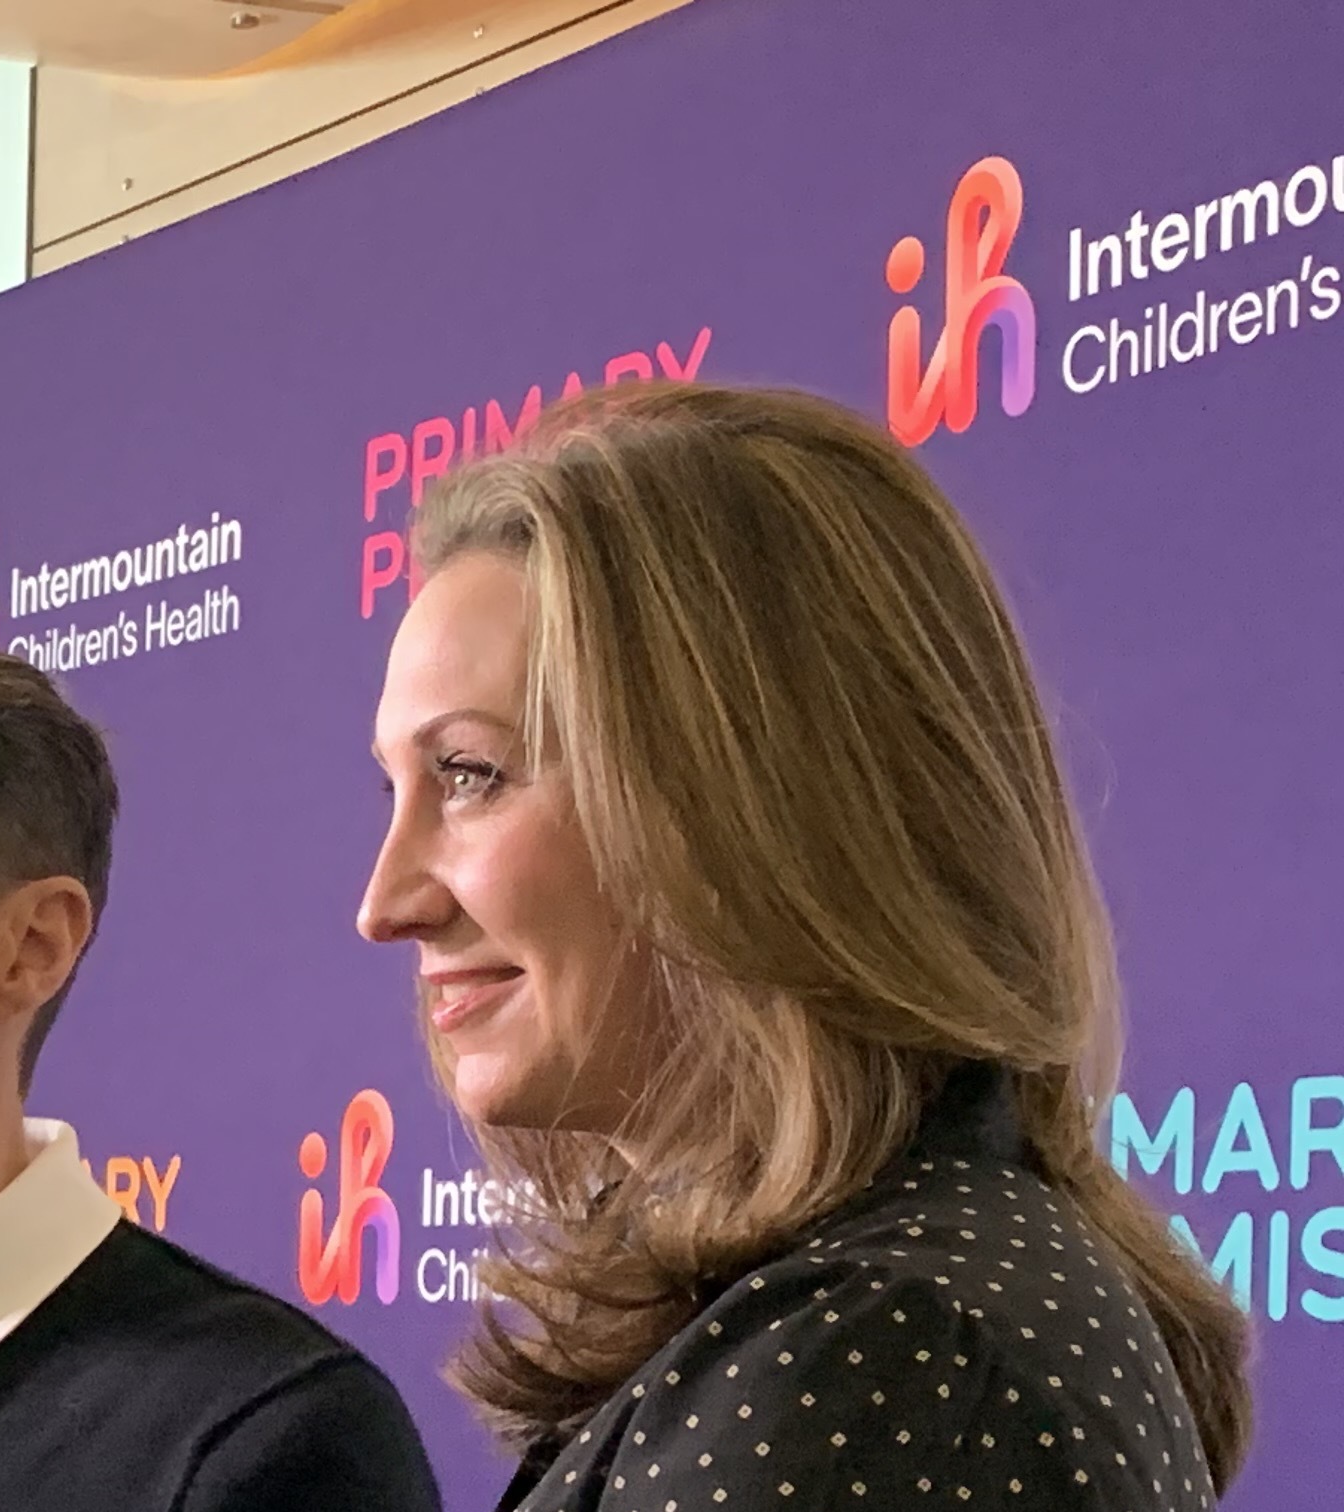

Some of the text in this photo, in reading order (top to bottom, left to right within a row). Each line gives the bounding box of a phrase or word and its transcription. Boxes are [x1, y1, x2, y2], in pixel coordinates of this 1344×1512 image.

[1061, 256, 1342, 394] Children's
[11, 511, 242, 618] Intermountain
[144, 584, 240, 652] Health
[79, 1153, 182, 1233] RY
